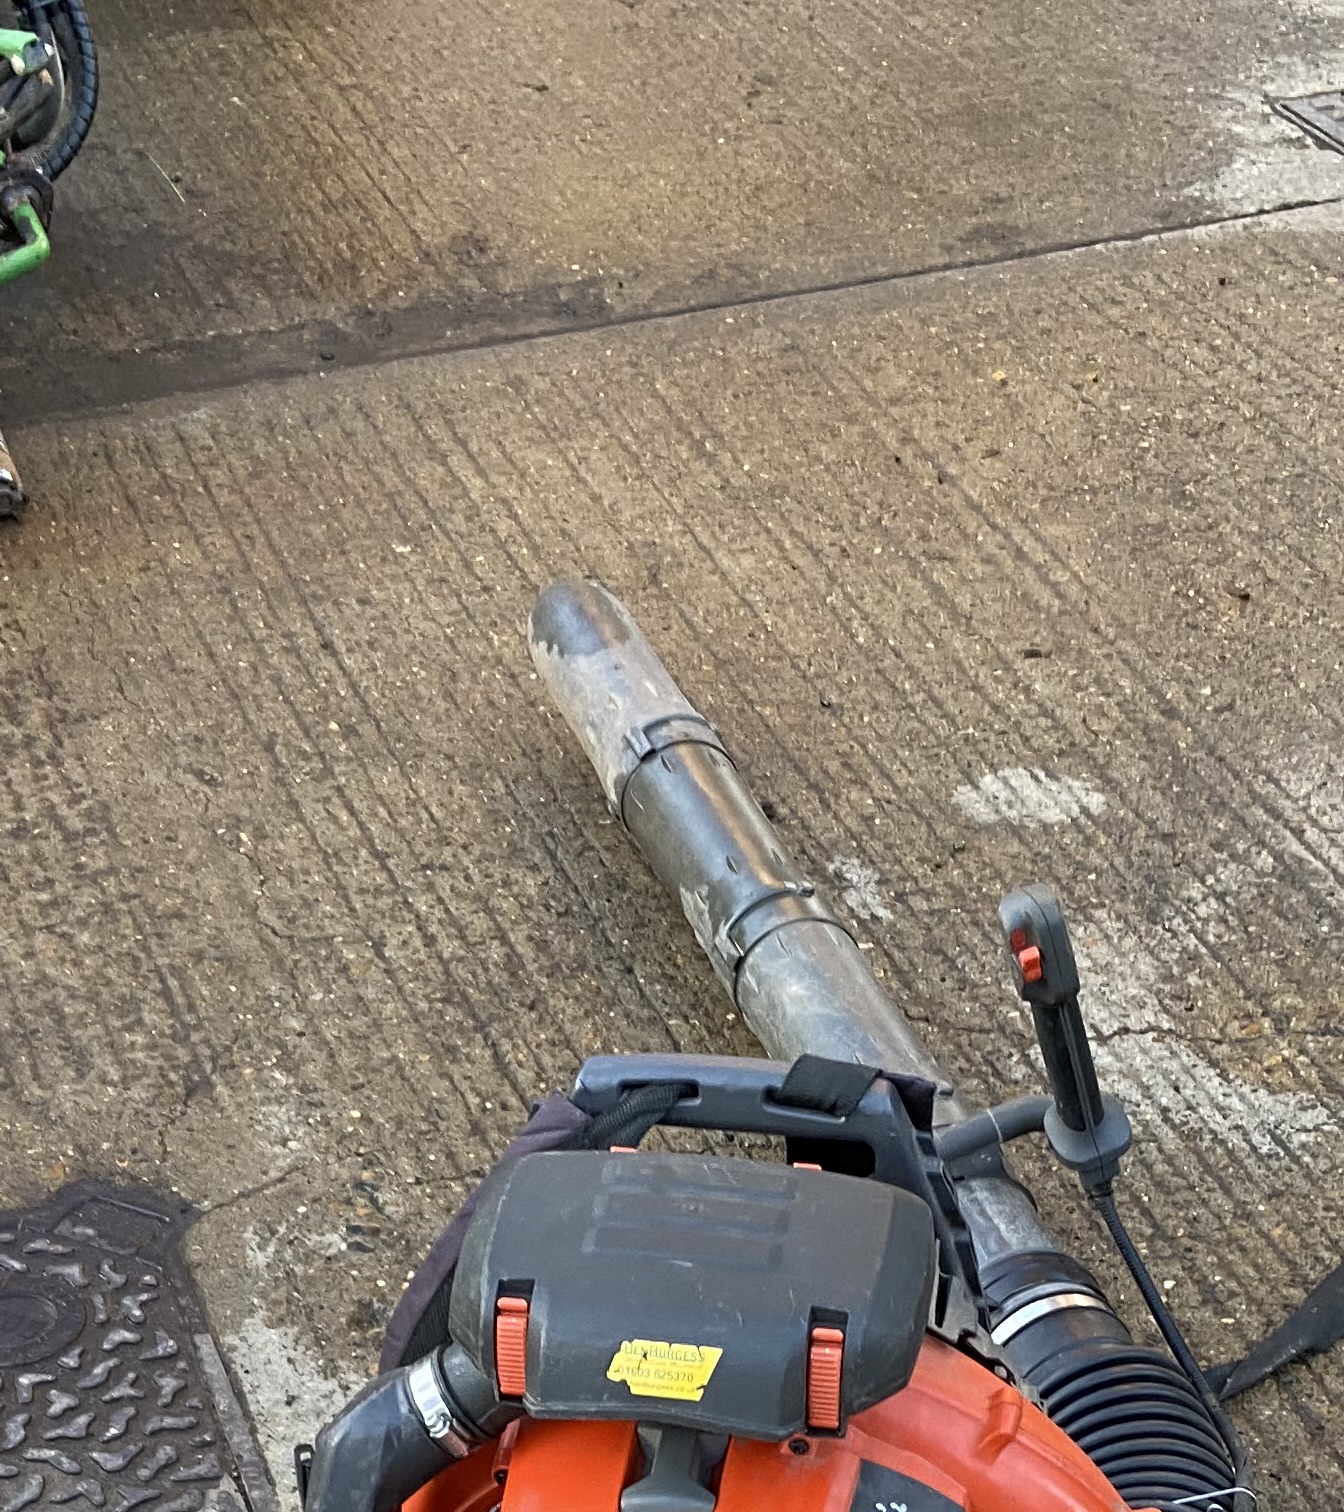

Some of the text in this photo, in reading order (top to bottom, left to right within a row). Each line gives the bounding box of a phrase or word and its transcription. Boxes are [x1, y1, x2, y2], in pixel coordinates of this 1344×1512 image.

[649, 1345, 706, 1362] BURGESS
[619, 1365, 694, 1383] 01603 625370
